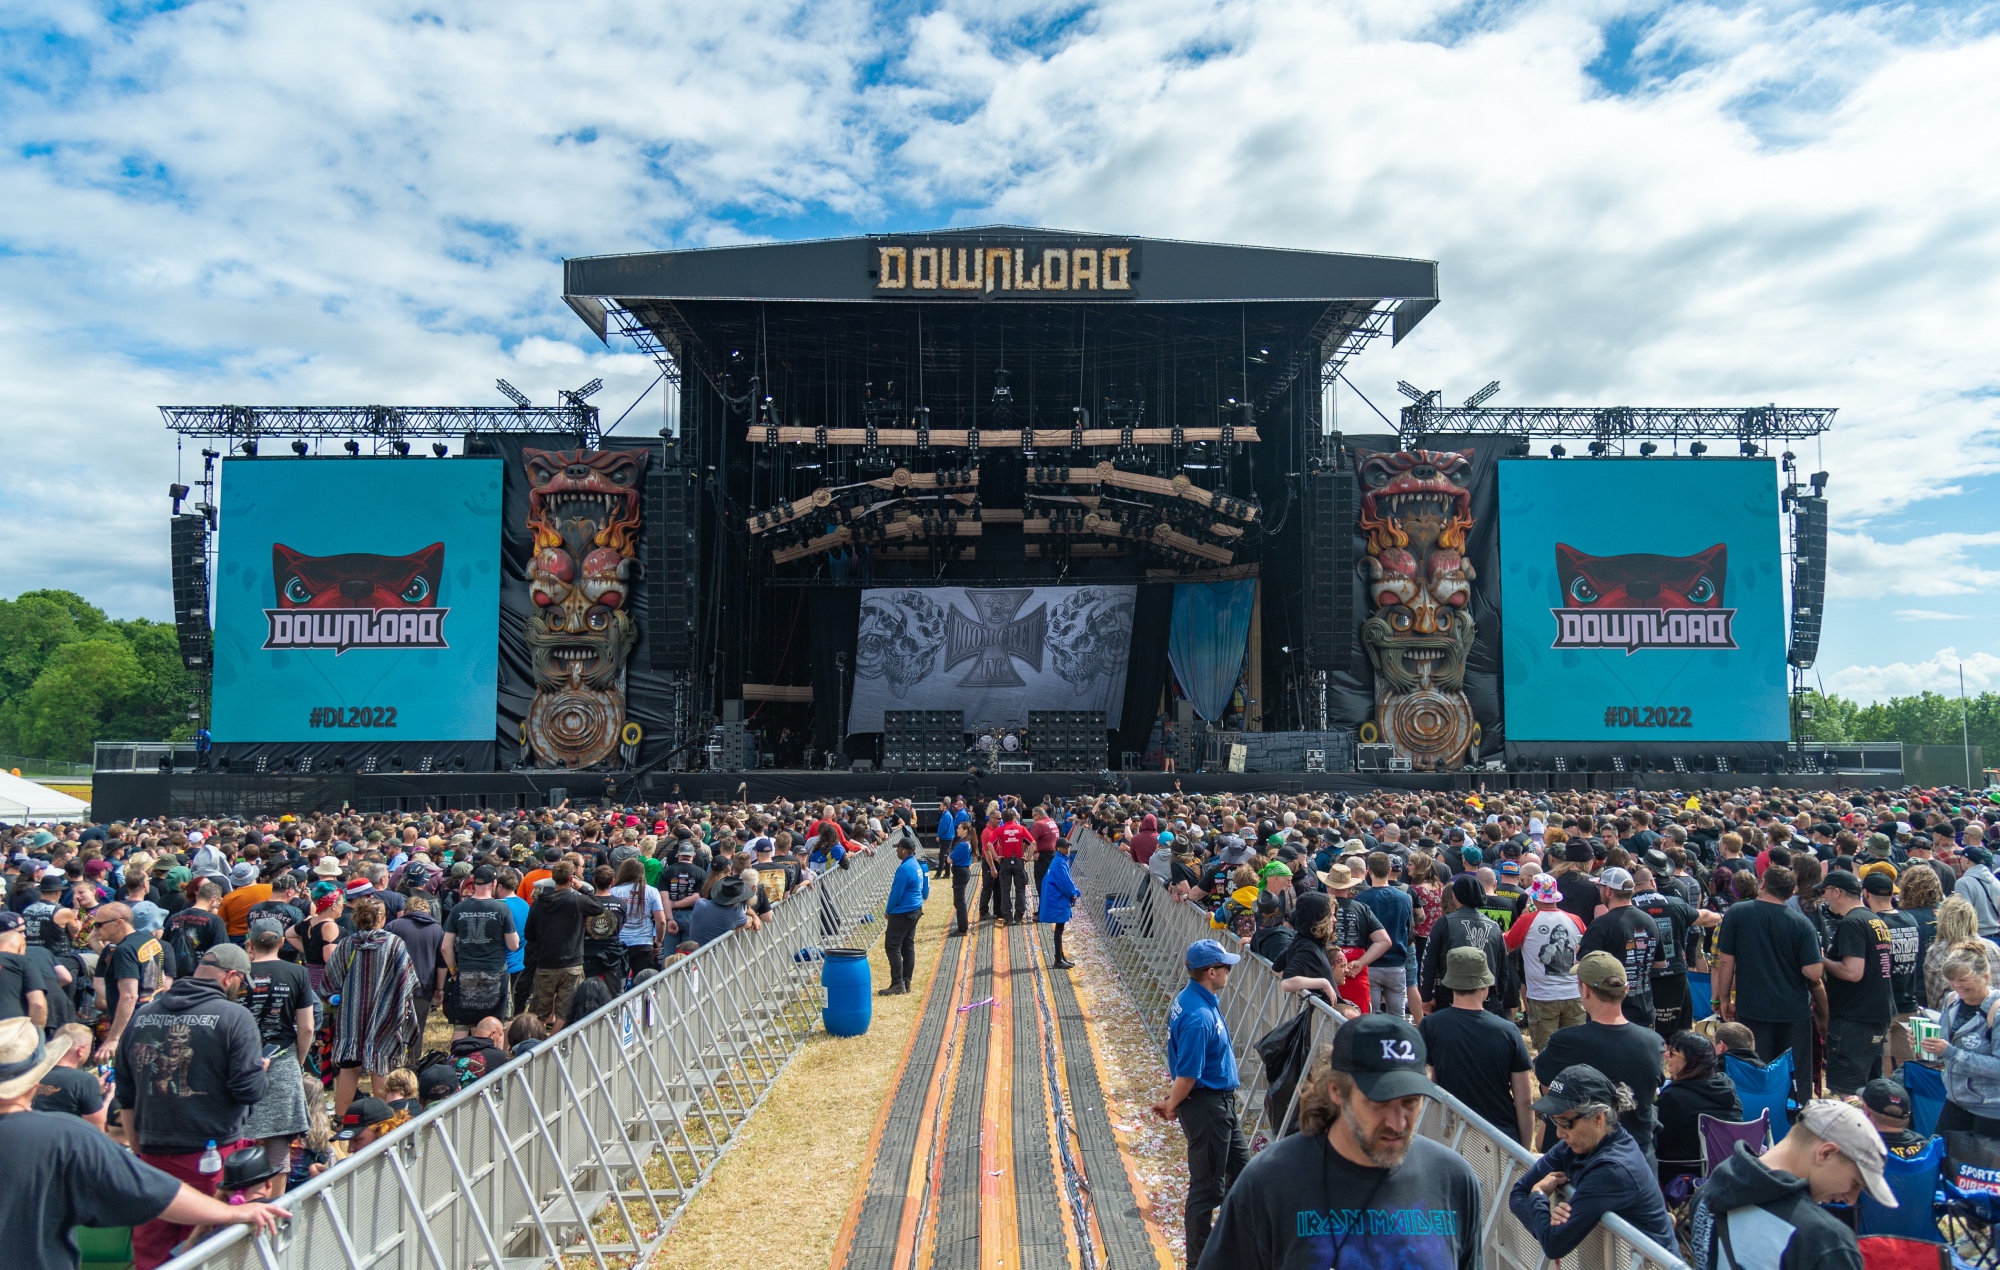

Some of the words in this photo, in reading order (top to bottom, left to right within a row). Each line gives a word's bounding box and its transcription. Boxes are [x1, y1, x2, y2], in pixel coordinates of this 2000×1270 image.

[877, 246, 1132, 293] DOWNLOAD
[272, 613, 440, 646] DOWNLOAD
[952, 614, 995, 657] DOOM
[1560, 613, 1728, 646] DOWNLOAD
[309, 706, 397, 728] #DL2022
[1604, 706, 1692, 728] #DL2022
[458, 911, 499, 921] MEGADETH
[164, 1014, 220, 1031] MAIDEN
[1380, 1039, 1416, 1061] K2
[1959, 1164, 2000, 1183] SPORTS
[1297, 1208, 1364, 1238] IRON
[1366, 1208, 1458, 1236] MAIDEN
